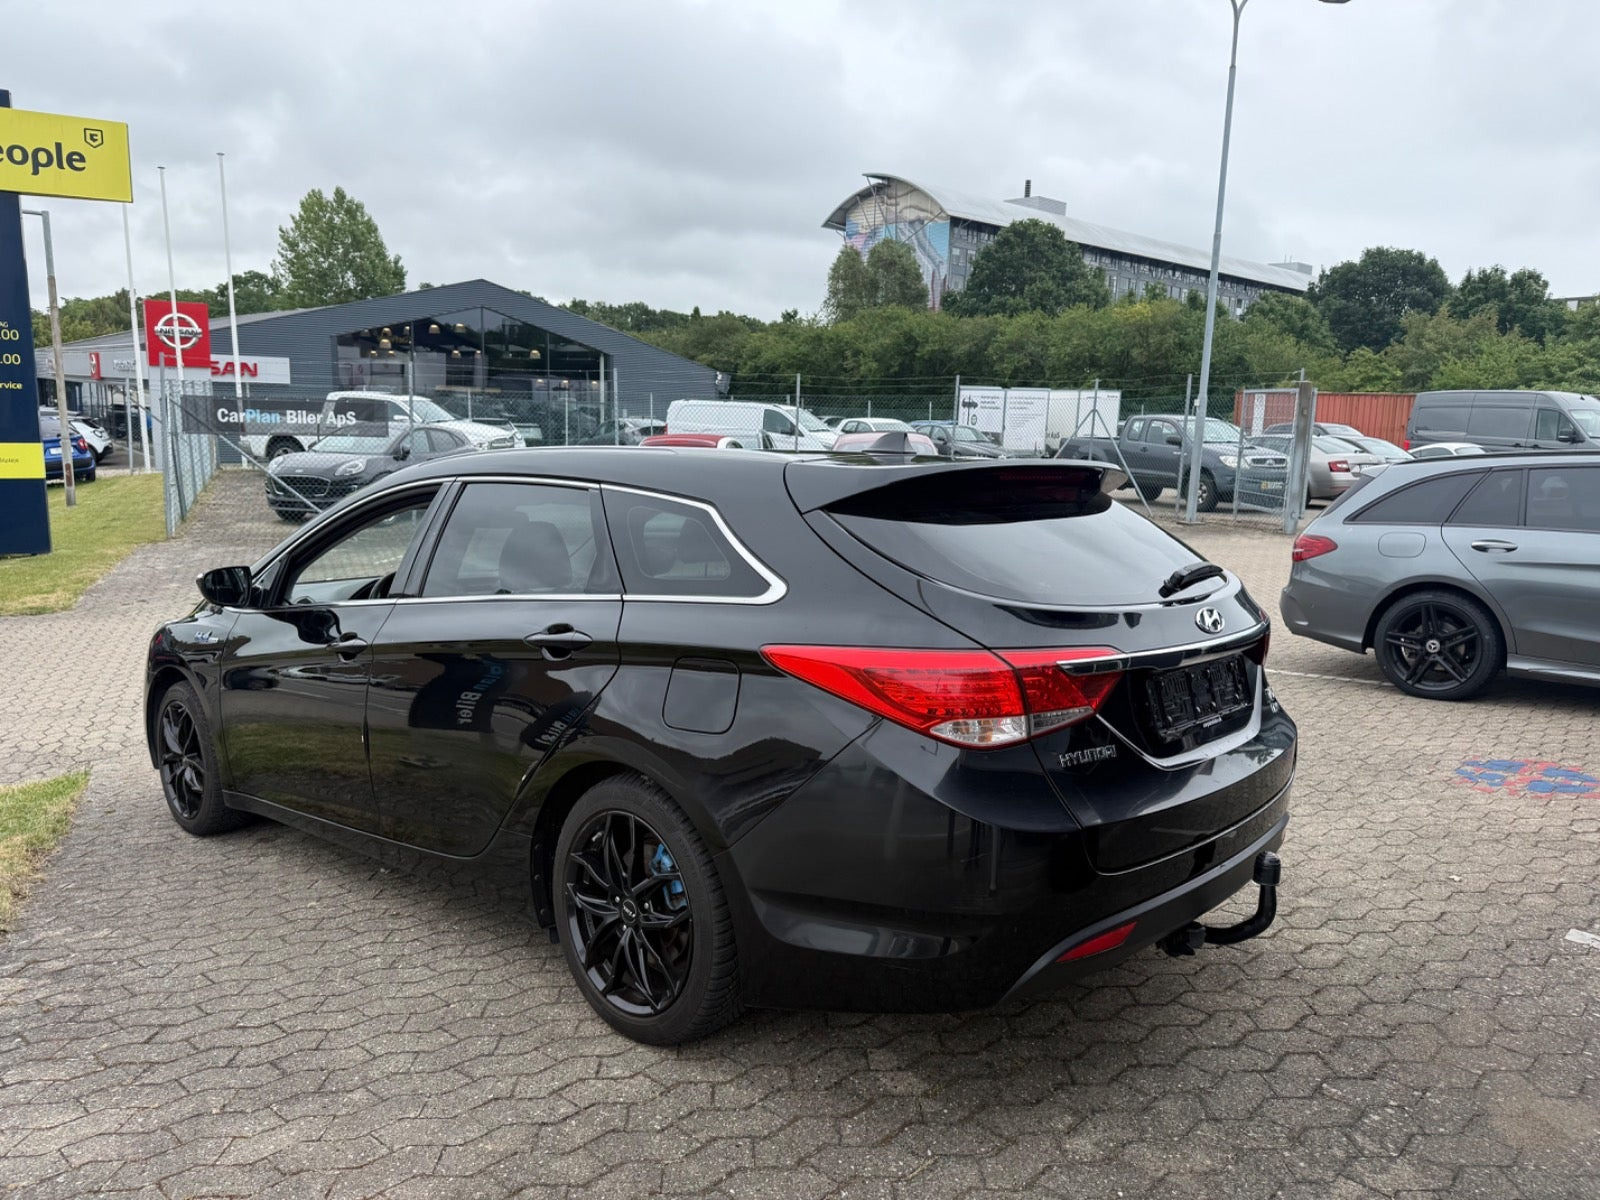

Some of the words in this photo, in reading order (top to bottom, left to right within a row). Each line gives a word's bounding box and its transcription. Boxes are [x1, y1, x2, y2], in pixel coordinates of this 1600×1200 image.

[0, 142, 86, 176] ople
[217, 408, 281, 424] CarPlan
[286, 410, 323, 424] Biler
[326, 411, 357, 428] ApS
[1059, 744, 1117, 767] HYUNDAI
